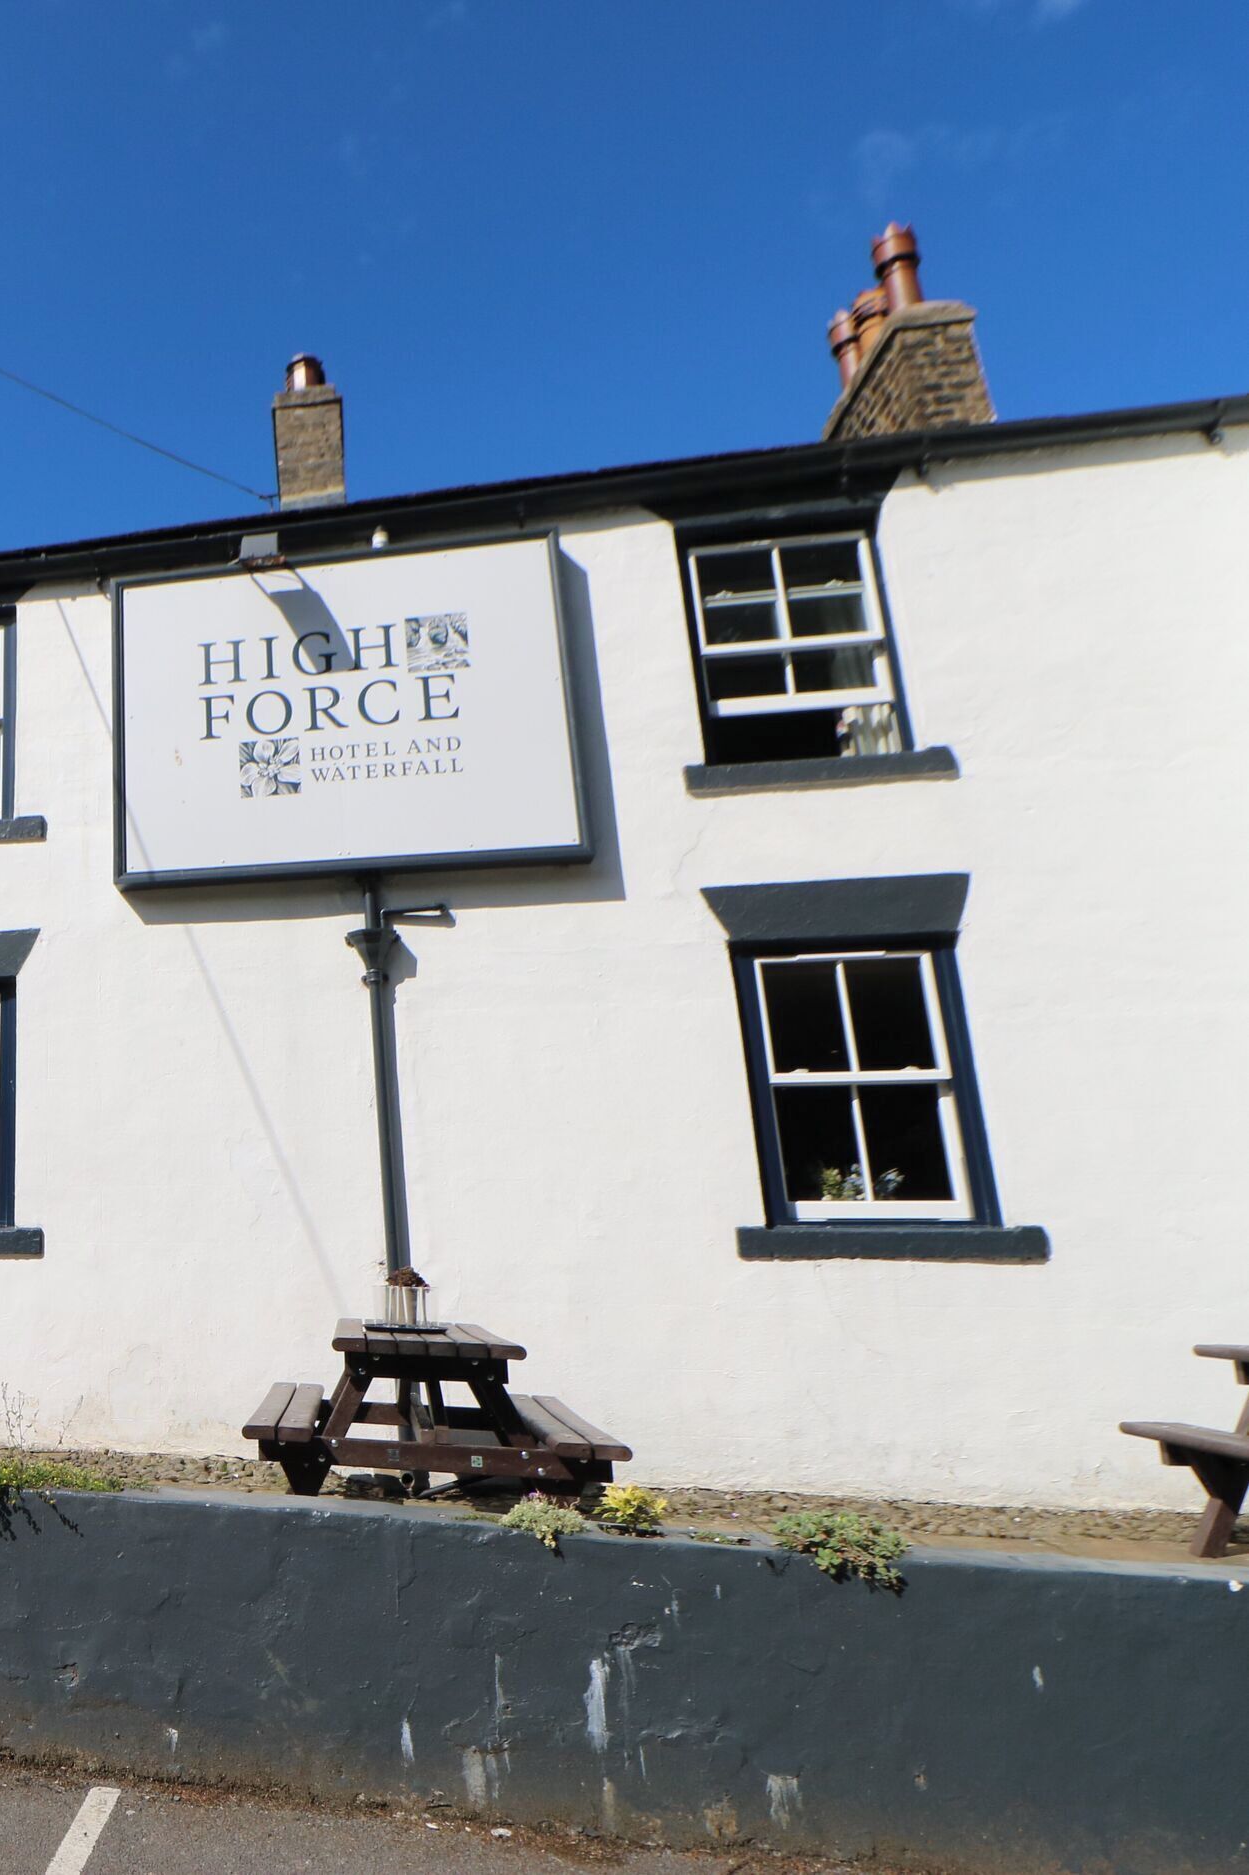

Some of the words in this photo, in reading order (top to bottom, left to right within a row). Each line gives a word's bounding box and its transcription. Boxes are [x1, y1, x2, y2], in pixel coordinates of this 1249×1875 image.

[197, 623, 400, 687] HIGH
[199, 673, 461, 741] FORCE
[310, 742, 396, 763] HOTEL
[406, 735, 462, 754] AND
[311, 757, 465, 783] WATERFALL
